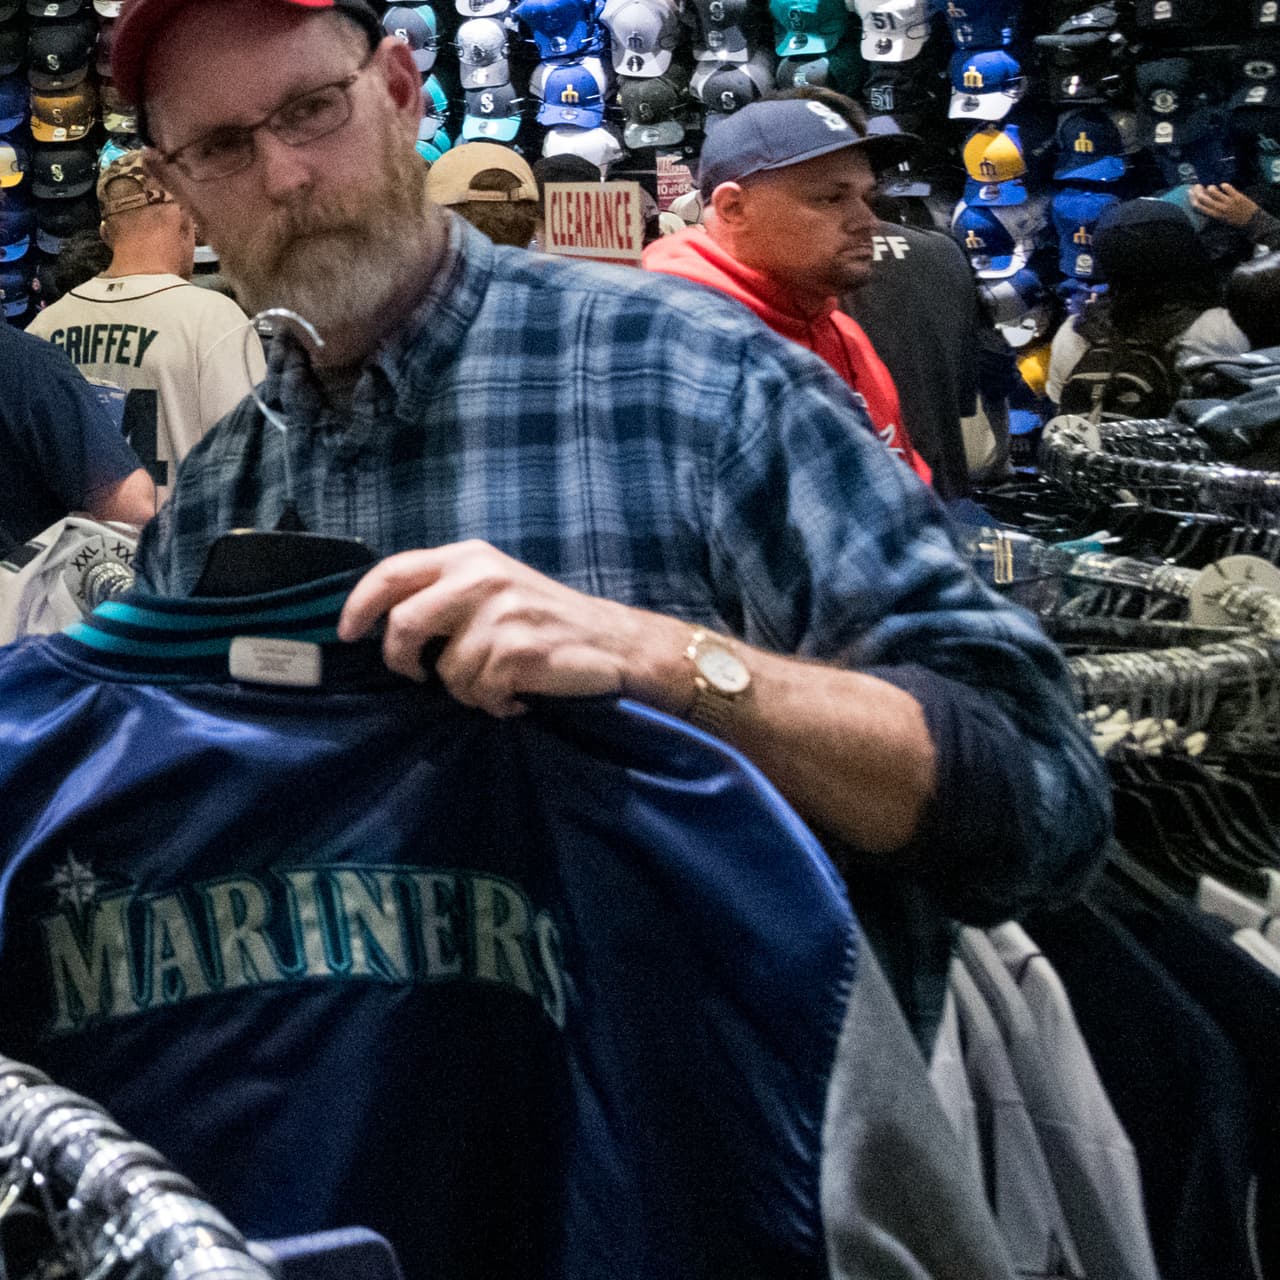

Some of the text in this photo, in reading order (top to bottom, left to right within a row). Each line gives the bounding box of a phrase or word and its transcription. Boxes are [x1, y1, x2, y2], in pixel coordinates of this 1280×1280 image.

[872, 11, 896, 30] 51
[870, 88, 894, 111] 51
[550, 190, 634, 250] CLEARANCE
[50, 323, 159, 368] GRIFFEY
[71, 542, 100, 571] XXL
[111, 542, 135, 568] XX
[41, 868, 570, 1031] MARINERS
